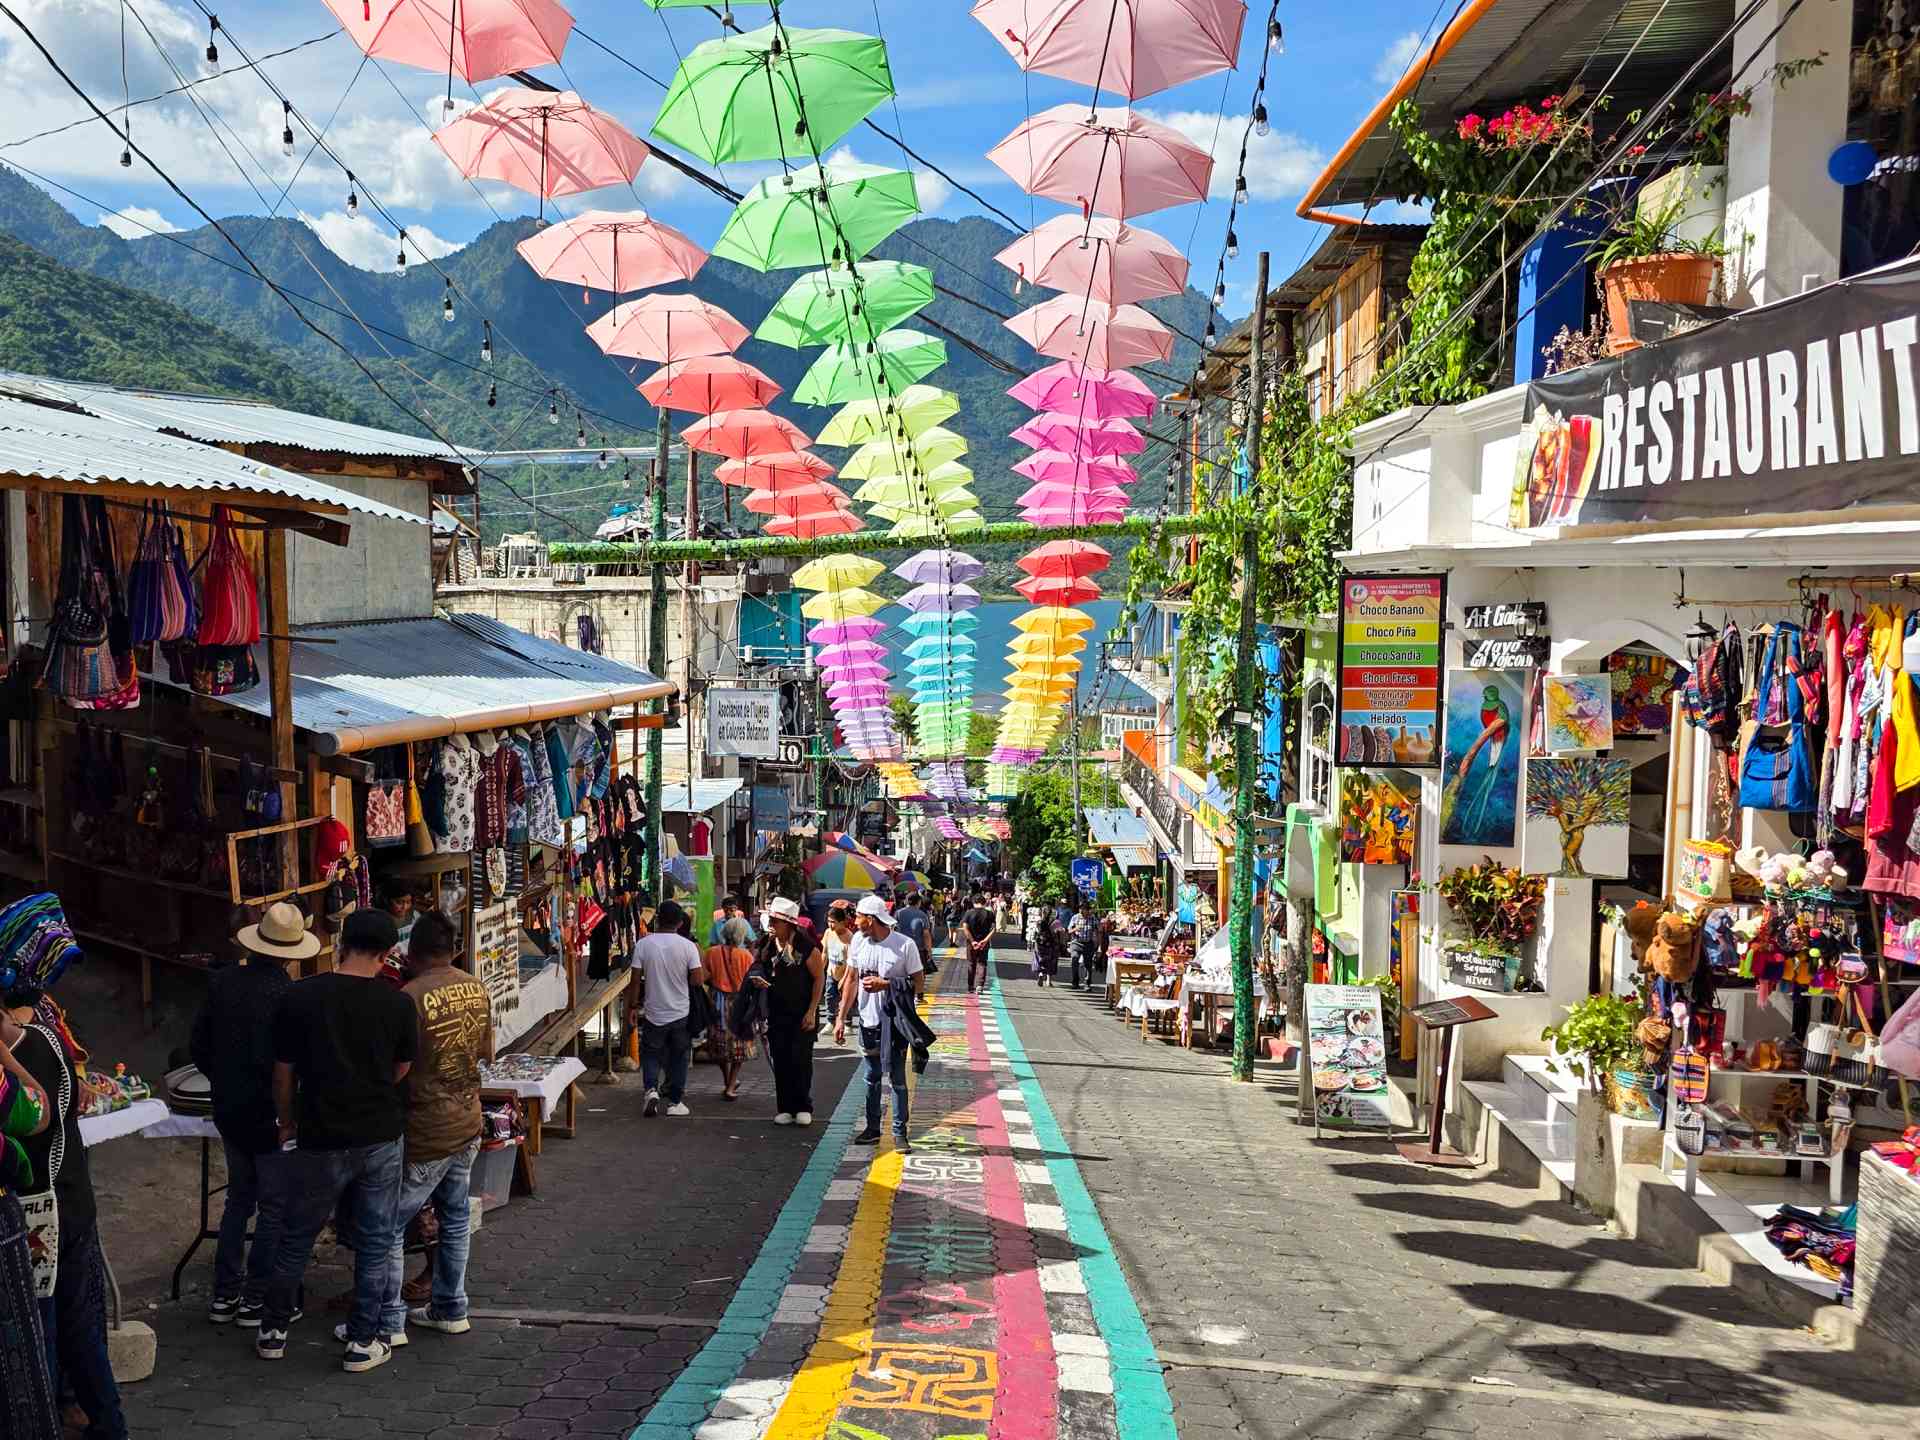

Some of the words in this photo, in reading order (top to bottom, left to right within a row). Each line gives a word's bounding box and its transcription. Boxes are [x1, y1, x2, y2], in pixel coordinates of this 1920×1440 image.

[1598, 315, 1920, 490] RESTAURANT
[1360, 604, 1387, 616] Choco
[1390, 604, 1424, 616] Banano
[1465, 606, 1491, 628] Art
[1366, 626, 1393, 637] Choco
[1396, 625, 1416, 637] Piña
[1360, 650, 1387, 661] Choco
[1392, 672, 1417, 683] Fresa
[1370, 713, 1407, 724] Helados
[24, 1199, 53, 1214] ALA
